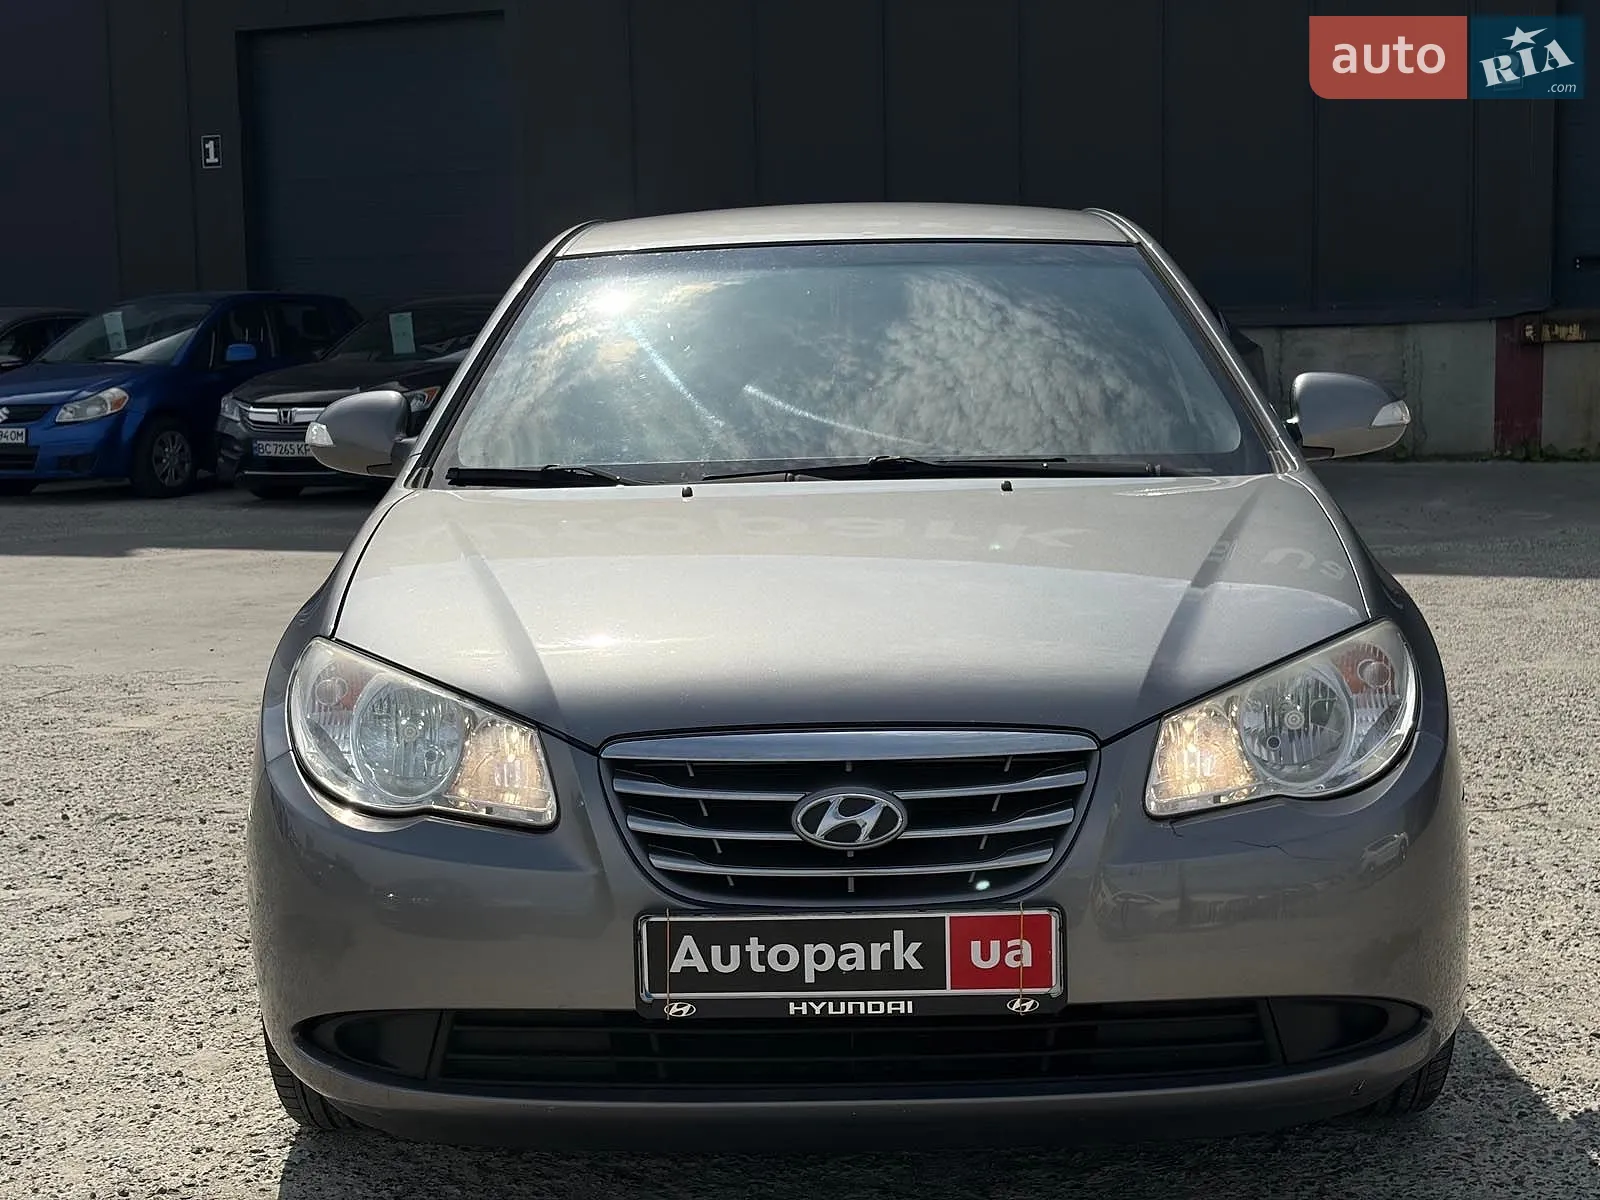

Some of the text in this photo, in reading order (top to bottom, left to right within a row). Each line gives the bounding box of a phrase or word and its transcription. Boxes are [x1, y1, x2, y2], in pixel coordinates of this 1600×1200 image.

[205, 140, 219, 163] 1
[669, 929, 1033, 984] Autopark ua
[788, 1000, 913, 1015] HYUNDAI
